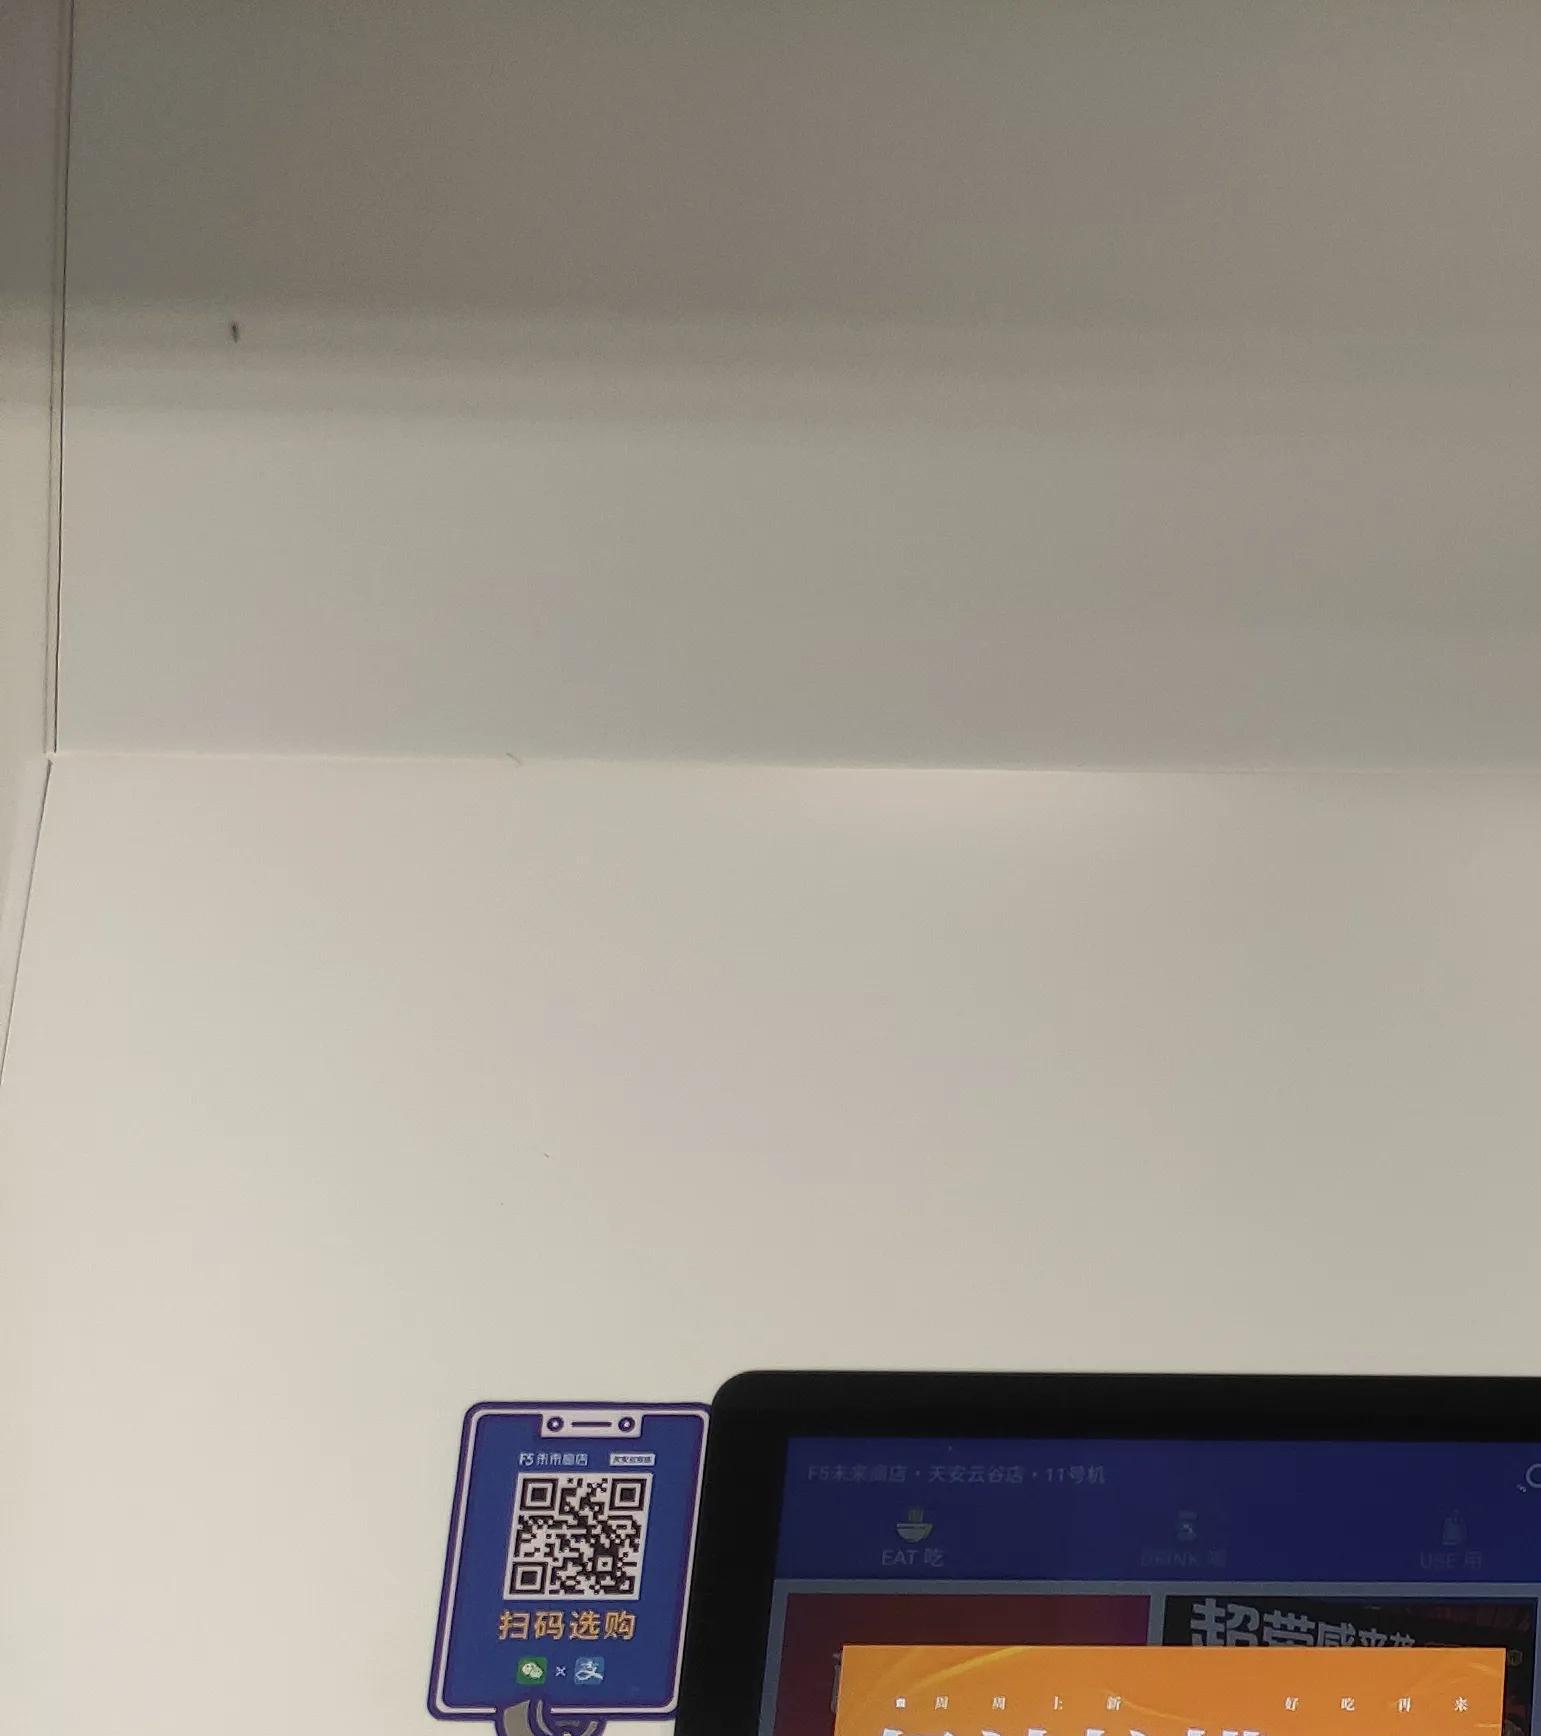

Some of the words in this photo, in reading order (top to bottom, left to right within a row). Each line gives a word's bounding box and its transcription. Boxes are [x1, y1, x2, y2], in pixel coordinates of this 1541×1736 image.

[881, 1549, 918, 1566] EAT
[498, 1609, 637, 1640] 扫码选购
